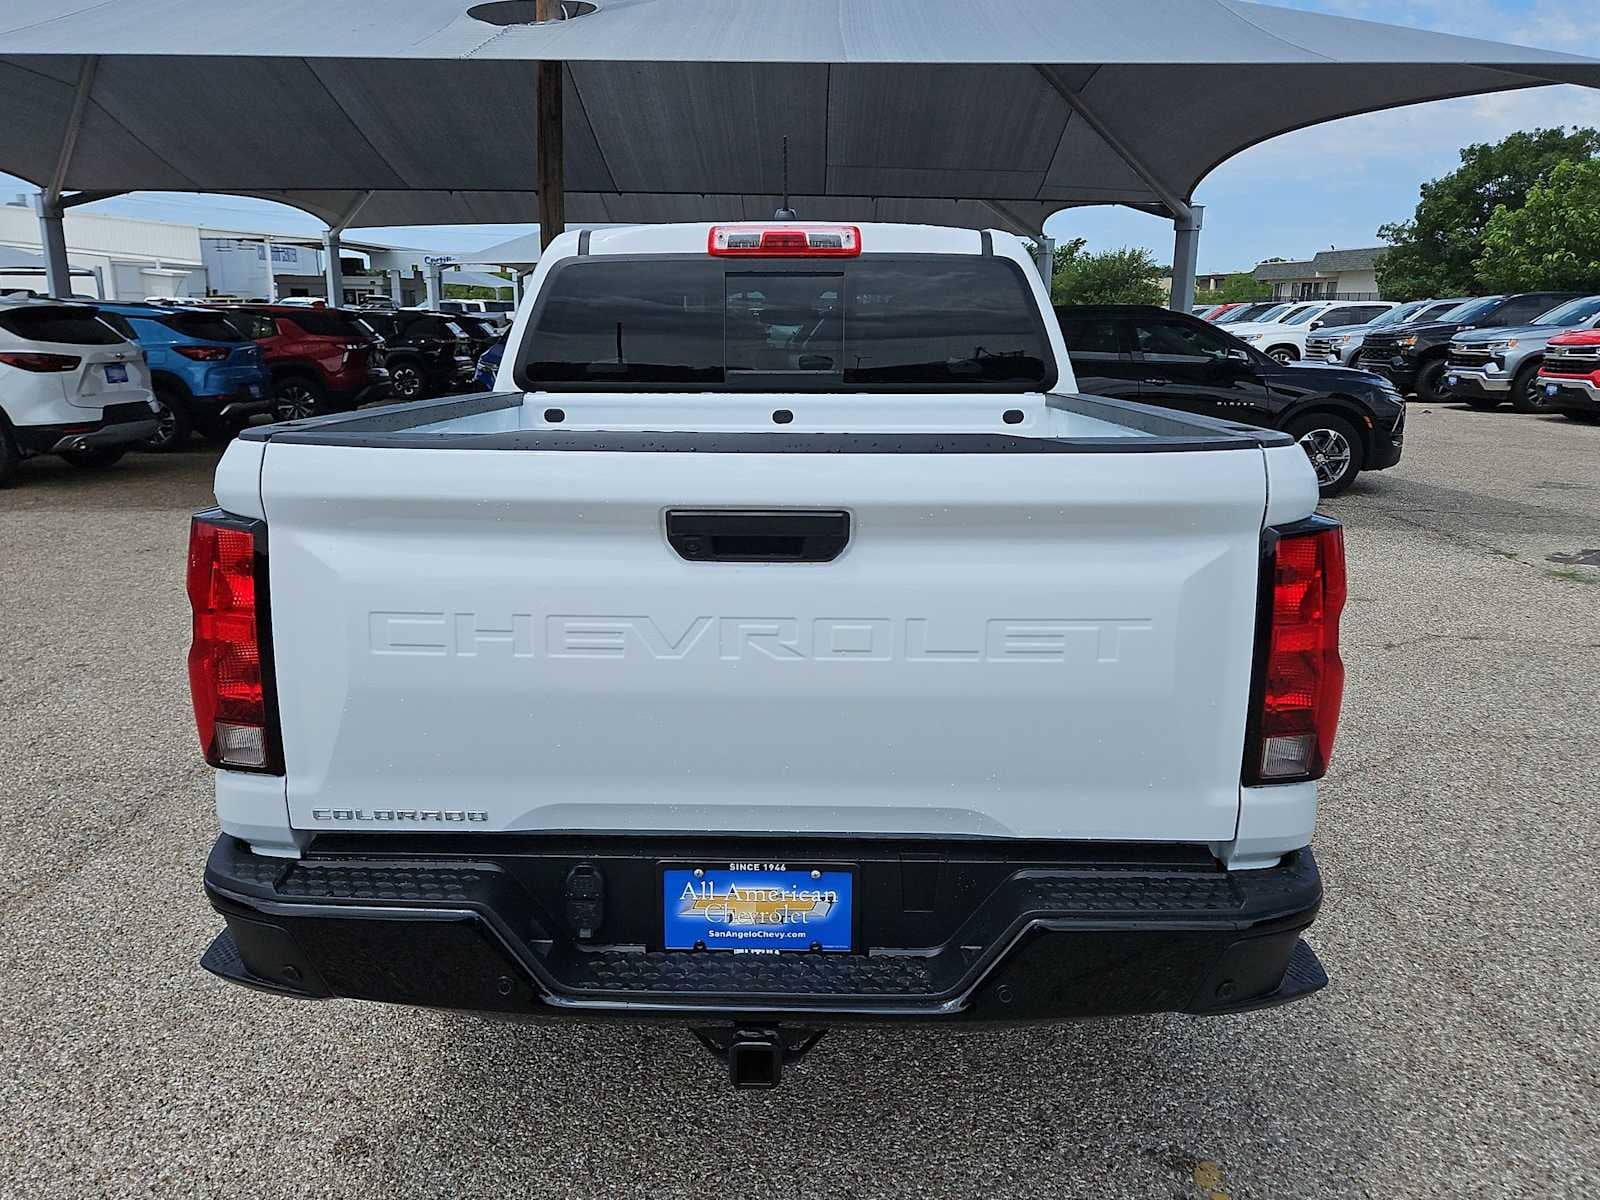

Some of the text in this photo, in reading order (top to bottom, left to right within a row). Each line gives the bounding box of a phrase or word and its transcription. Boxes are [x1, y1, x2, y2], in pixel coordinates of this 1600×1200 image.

[368, 611, 1153, 663] CHEVROLET
[312, 807, 489, 822] COLORADO
[729, 863, 787, 872] SINCE 1946
[679, 881, 839, 903] All American
[704, 903, 810, 924] Chevrolet
[708, 930, 807, 940] SanAngeloChevy.com
